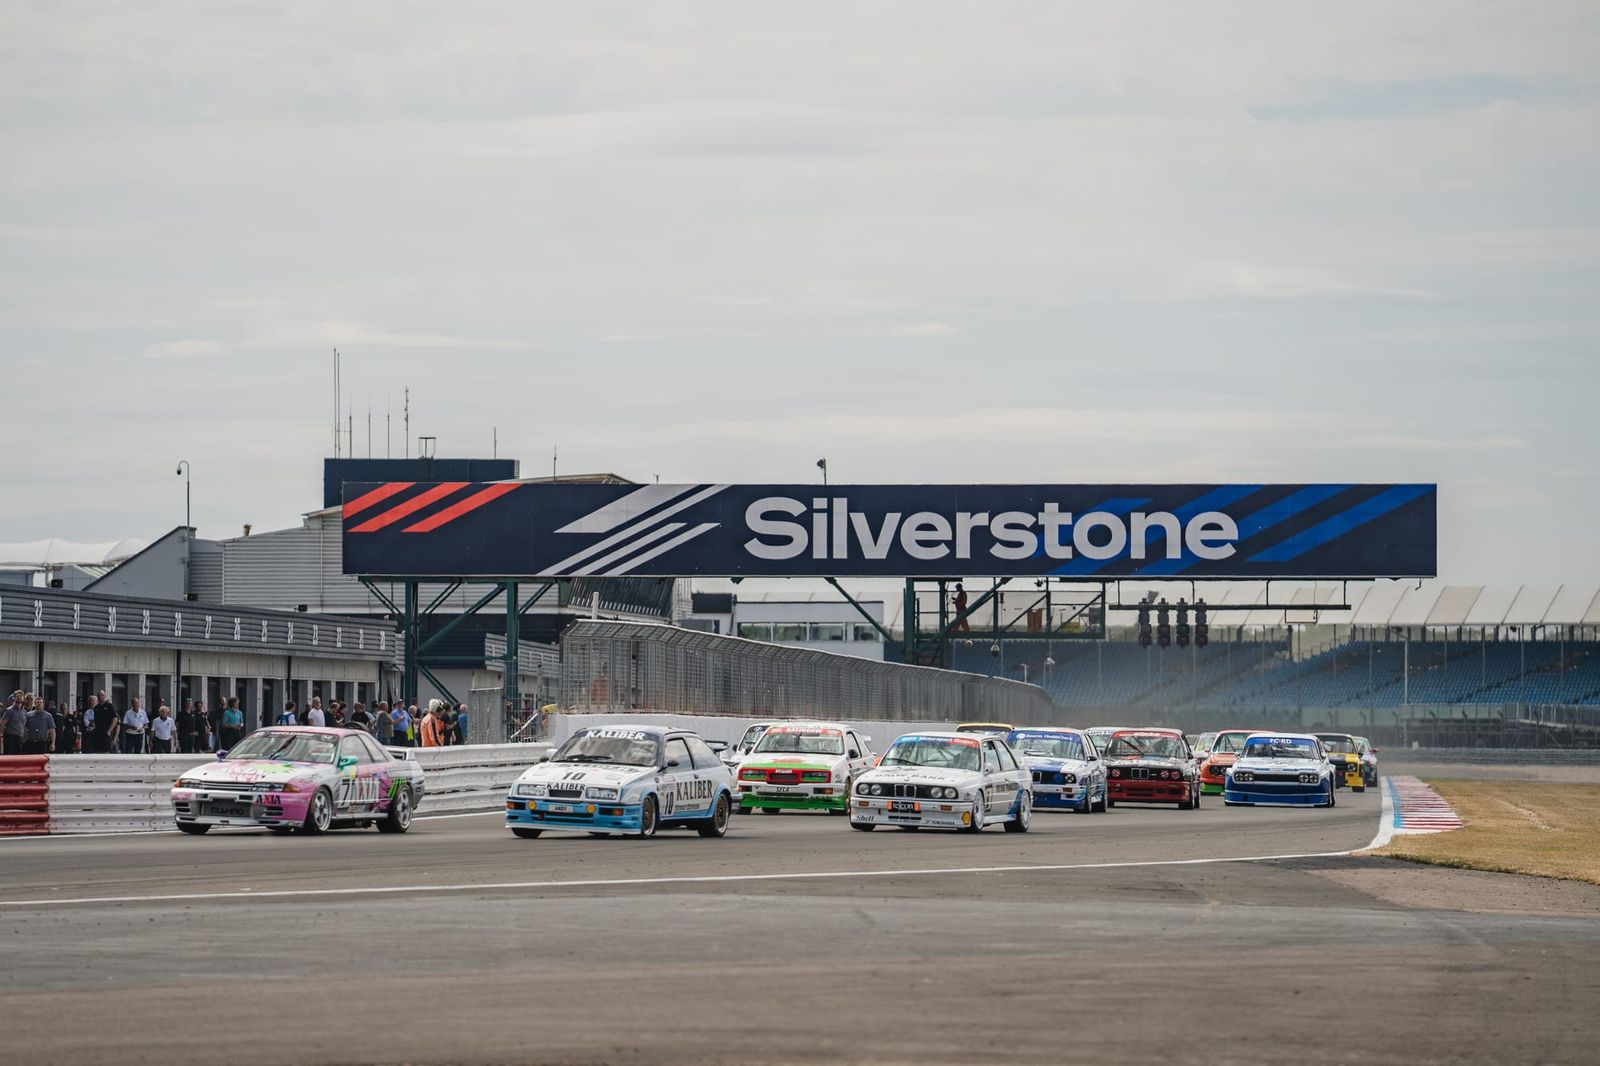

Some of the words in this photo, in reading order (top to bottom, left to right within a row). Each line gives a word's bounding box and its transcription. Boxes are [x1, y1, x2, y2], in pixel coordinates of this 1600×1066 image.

[743, 496, 1239, 561] Silverstone
[34, 600, 43, 627] 32
[584, 729, 646, 741] KALIBER
[562, 771, 587, 781] 10
[546, 782, 586, 791] KALIBER
[676, 779, 713, 801] KALIBER
[256, 794, 282, 805] AXIA
[664, 791, 674, 815] 10
